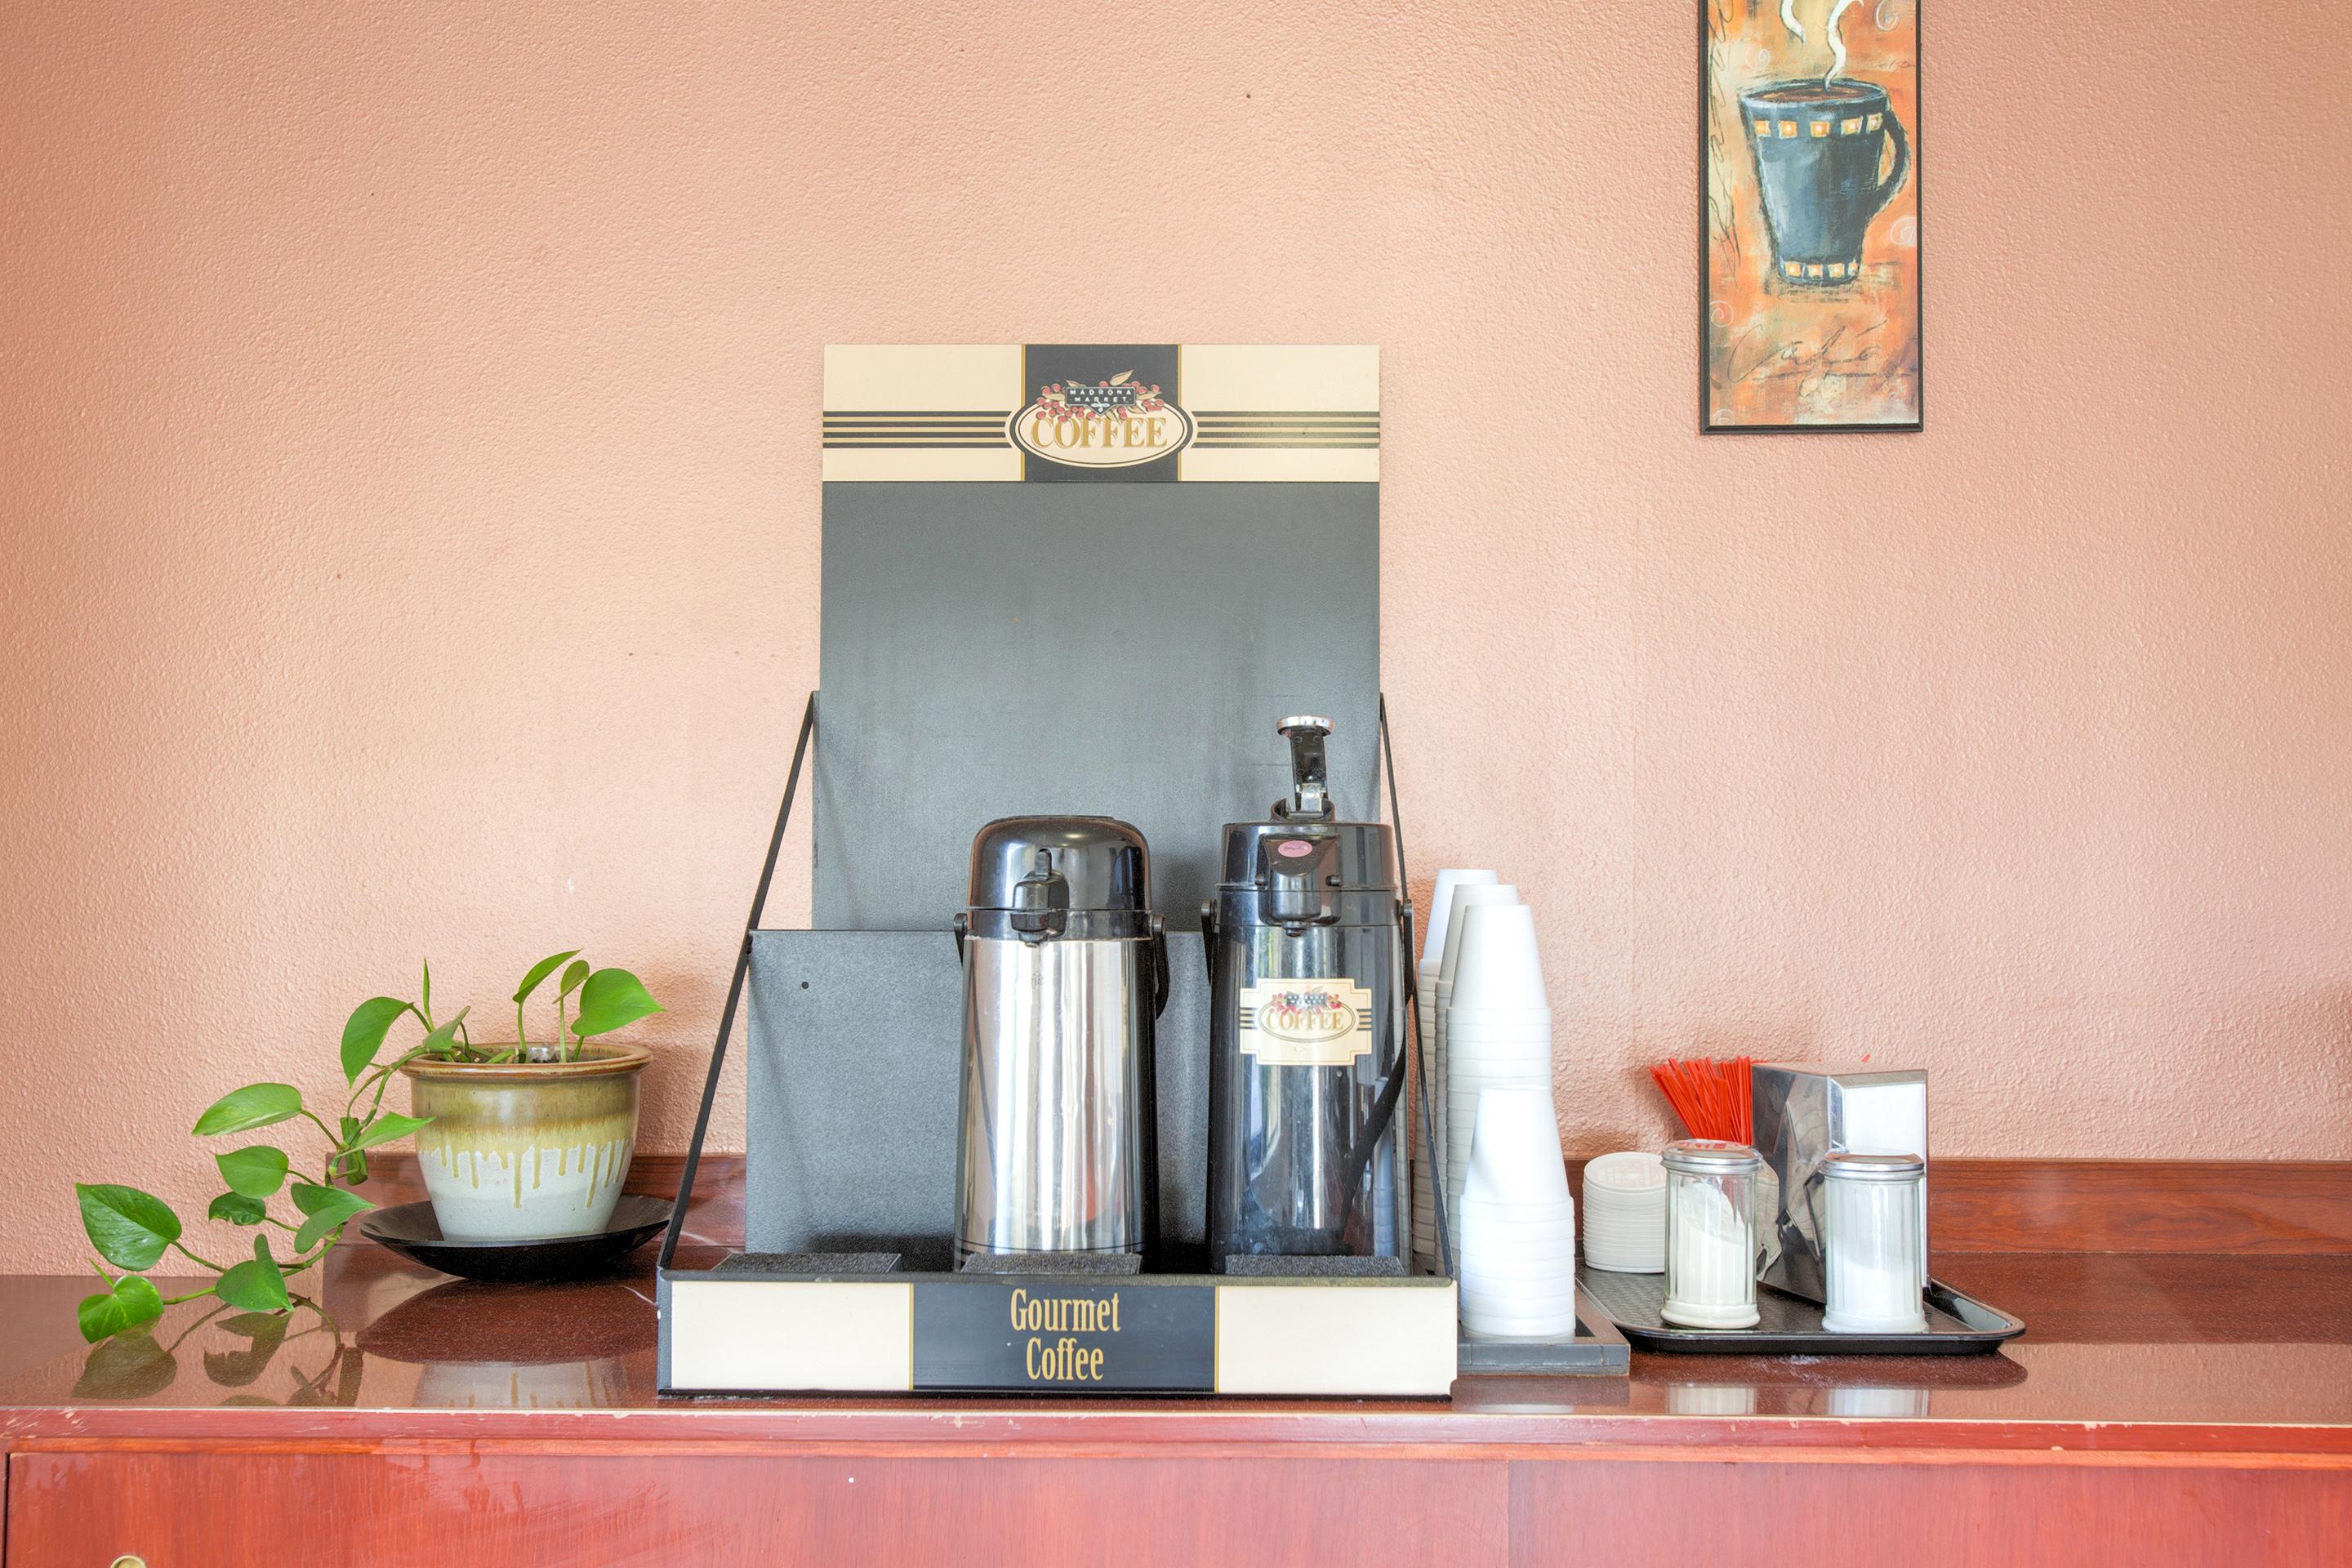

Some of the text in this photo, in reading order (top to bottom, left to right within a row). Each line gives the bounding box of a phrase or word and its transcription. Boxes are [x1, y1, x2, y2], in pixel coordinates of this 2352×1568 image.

[1031, 416, 1168, 448] COFFEE
[1267, 1011, 1344, 1031] COFFEE
[1010, 1288, 1121, 1332] Gourmet
[1026, 1337, 1104, 1381] Coffee
